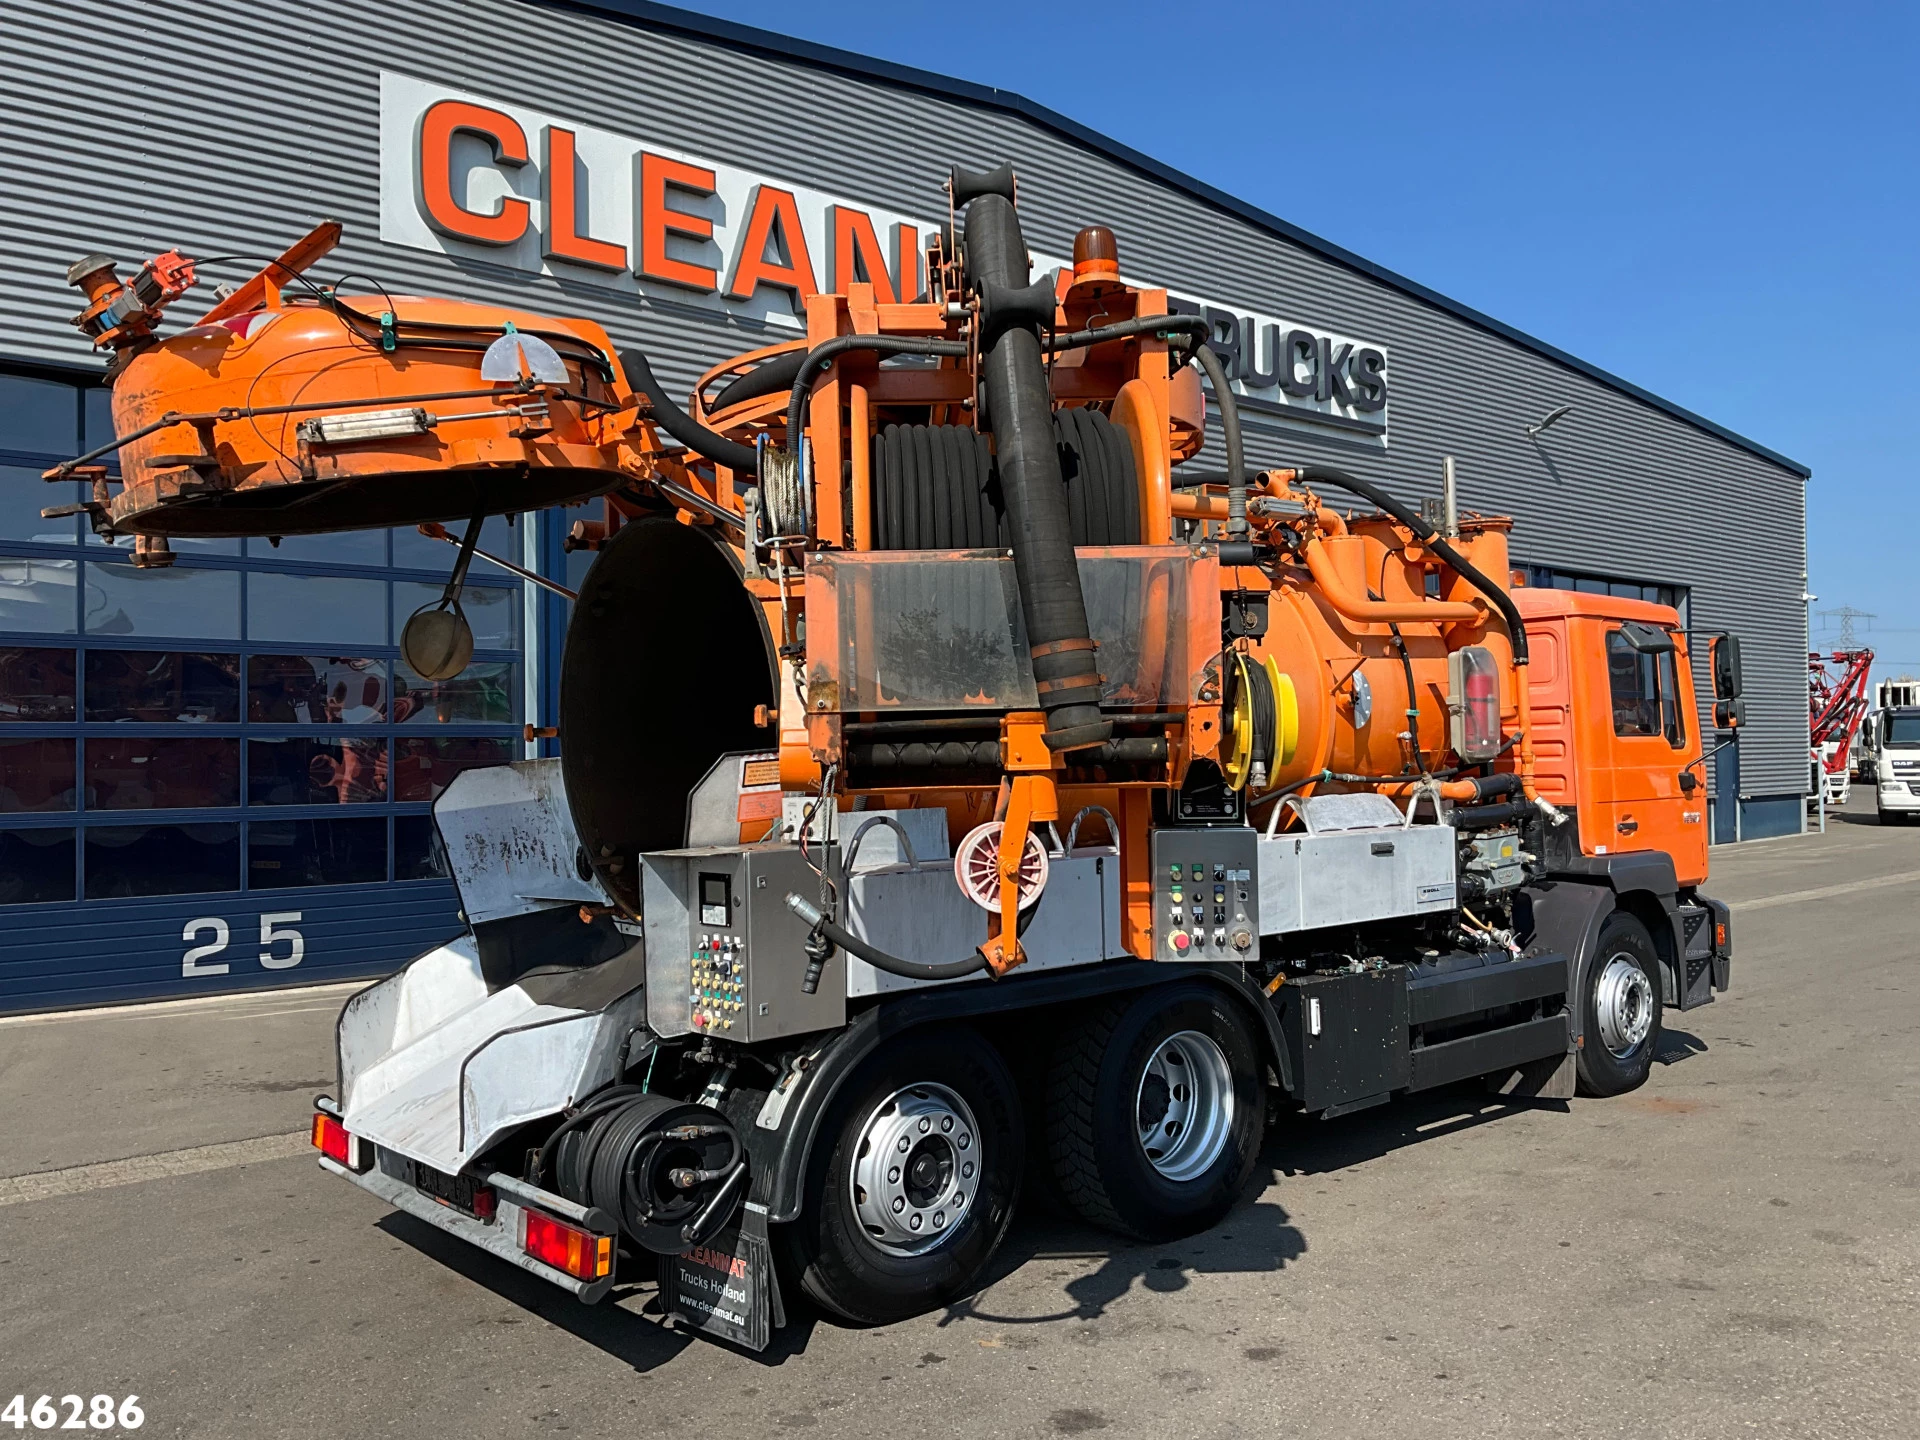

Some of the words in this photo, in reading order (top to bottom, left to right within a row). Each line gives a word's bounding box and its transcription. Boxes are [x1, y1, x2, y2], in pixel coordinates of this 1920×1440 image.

[413, 98, 1075, 325] CLEAN
[680, 1268, 709, 1290] Trucks
[711, 1279, 745, 1303] Holland
[680, 1294, 745, 1326] www.cleanmat.eu
